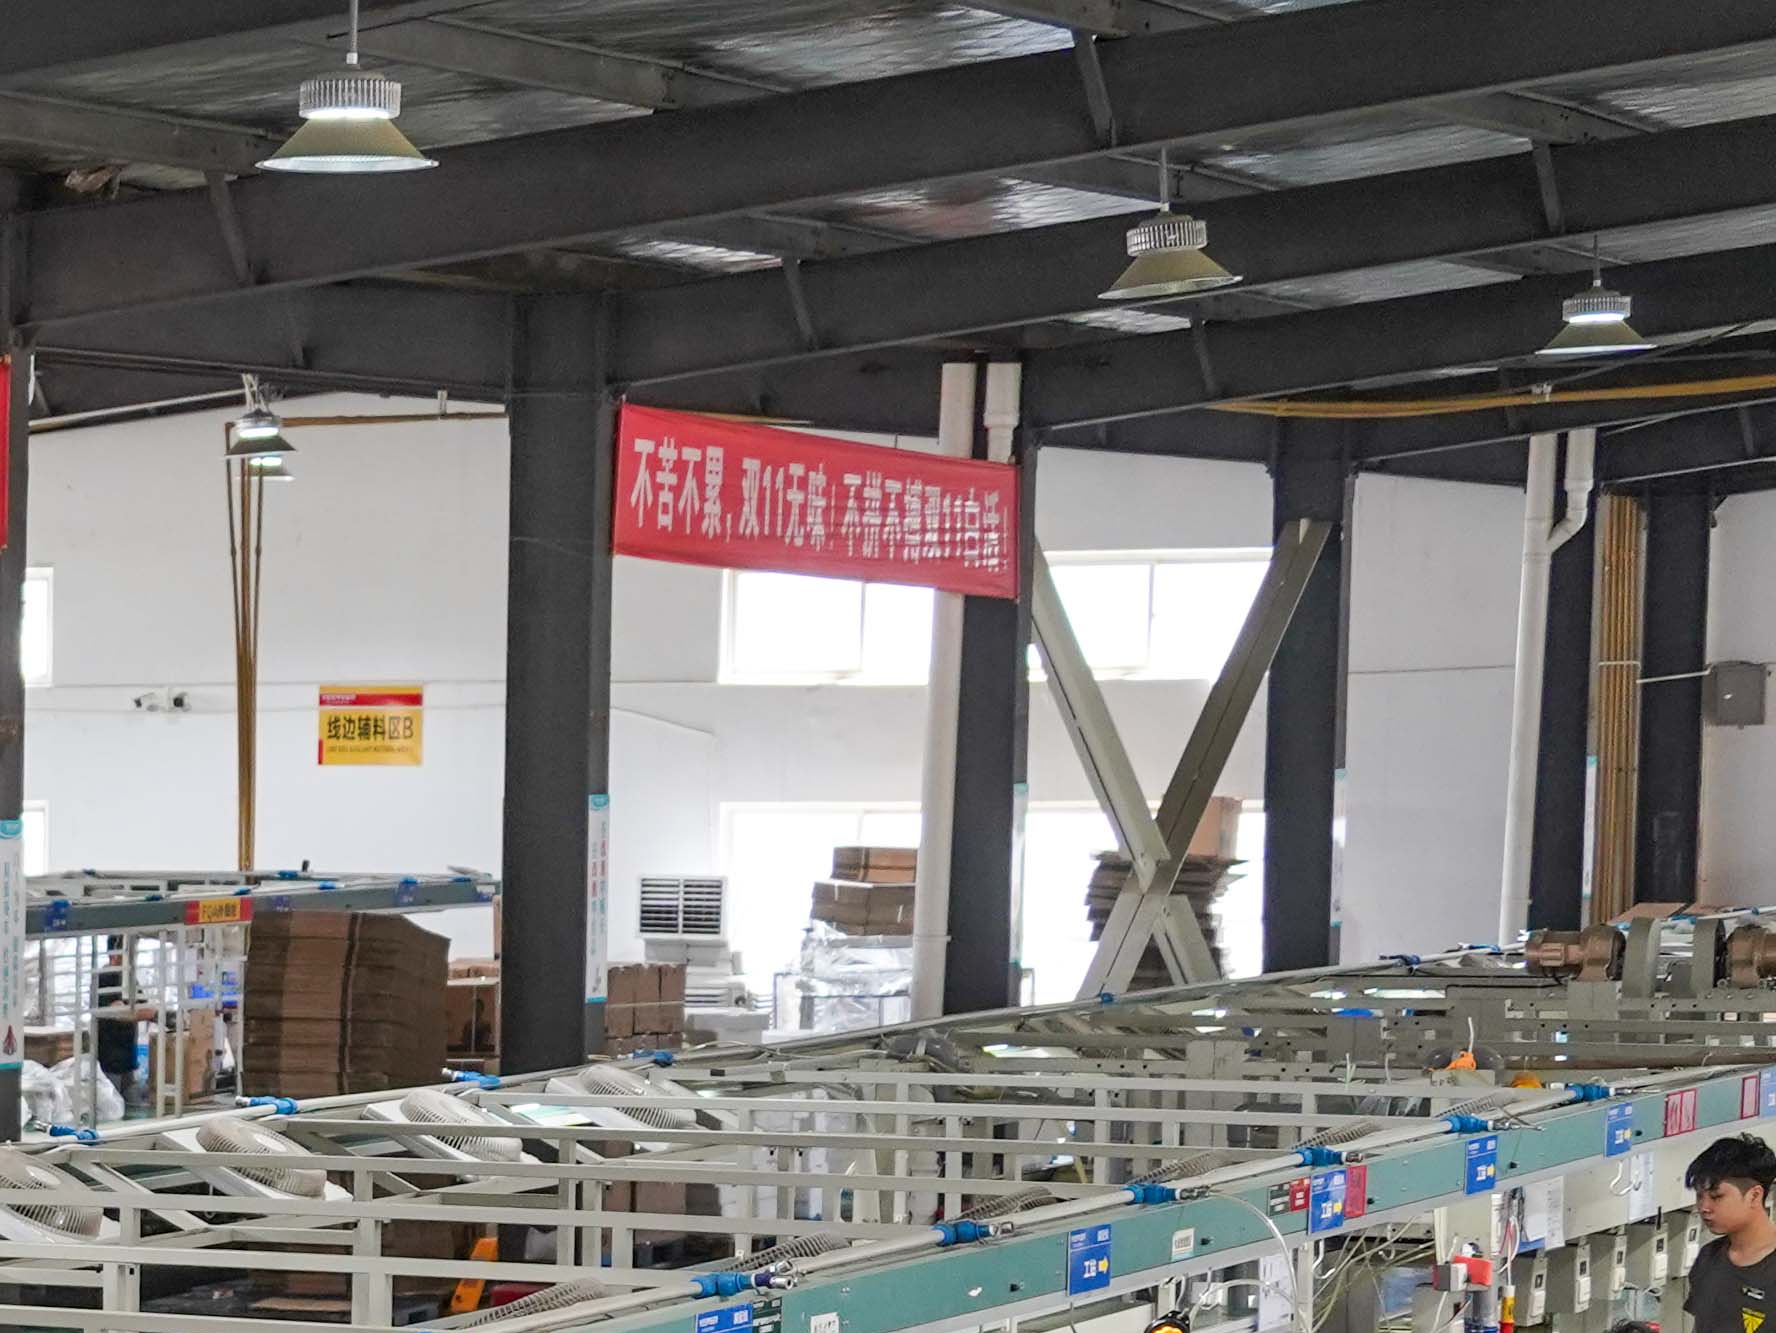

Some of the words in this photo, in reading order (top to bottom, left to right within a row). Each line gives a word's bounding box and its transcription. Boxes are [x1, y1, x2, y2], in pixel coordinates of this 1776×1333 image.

[326, 714, 415, 742] 线边辅料区B
